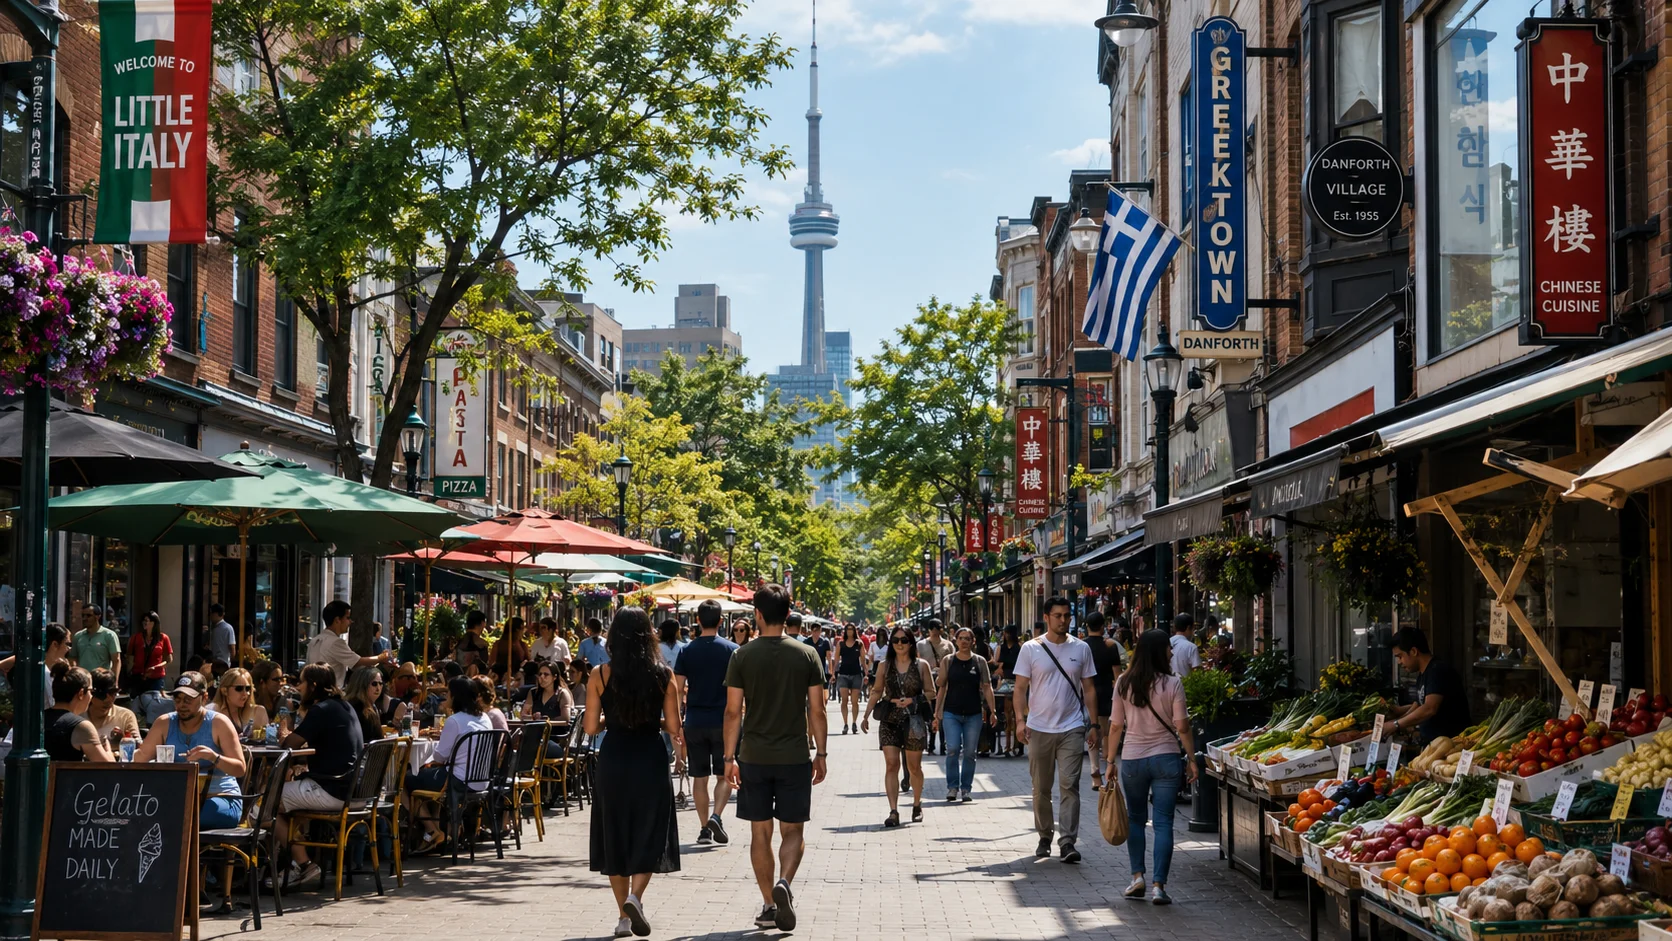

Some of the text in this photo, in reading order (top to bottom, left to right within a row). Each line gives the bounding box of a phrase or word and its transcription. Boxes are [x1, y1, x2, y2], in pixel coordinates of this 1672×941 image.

[114, 55, 195, 75] WELCOME TO
[115, 94, 193, 127] LITTLE
[115, 132, 192, 170] ITALY
[1544, 52, 1596, 254] 中華樓
[1322, 158, 1390, 170] DANFORTH
[1208, 46, 1236, 304] GREEKTOWN
[1326, 183, 1387, 195] VILLAGE
[1333, 210, 1380, 221] Est. 1955
[1540, 280, 1602, 294] CHINESE
[1542, 299, 1600, 313] CUISINE
[1183, 336, 1259, 350] DANFORTH
[453, 367, 467, 467] PASTA
[442, 480, 477, 492] PIZZA
[74, 782, 159, 824] Gelato
[68, 827, 120, 849] MADE
